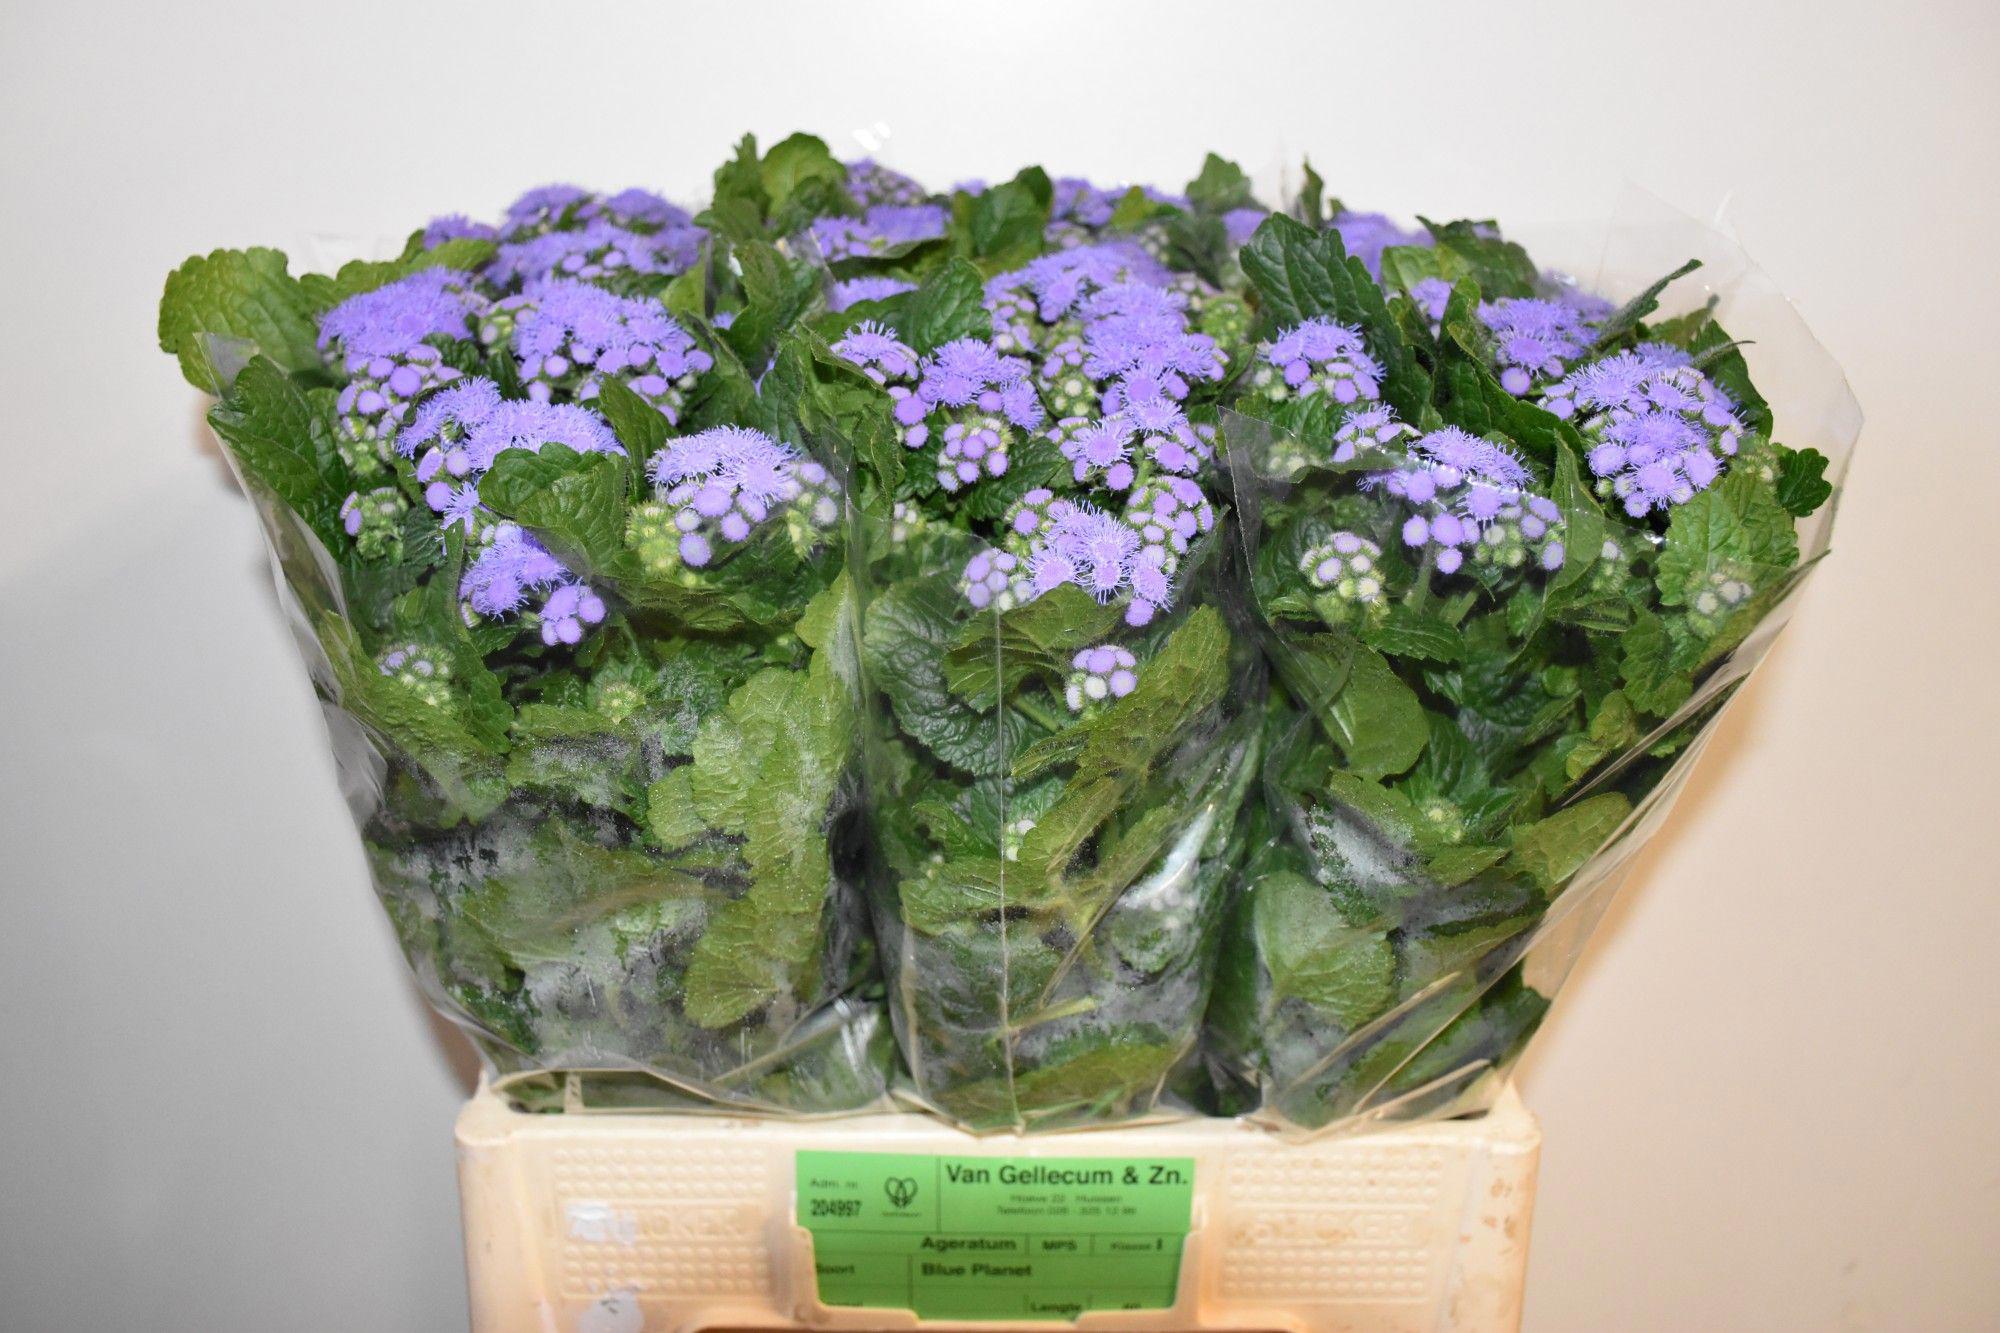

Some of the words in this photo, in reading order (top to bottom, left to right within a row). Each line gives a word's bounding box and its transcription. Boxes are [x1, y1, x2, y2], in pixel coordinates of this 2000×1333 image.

[946, 1164, 990, 1184] Van
[1000, 1165, 1113, 1184] Gellecum
[1123, 1166, 1138, 1184] &
[1148, 1166, 1188, 1184] Zn.
[921, 1237, 1017, 1252] Ageratum
[921, 1262, 966, 1276] Blue
[972, 1262, 1032, 1276] Planet
